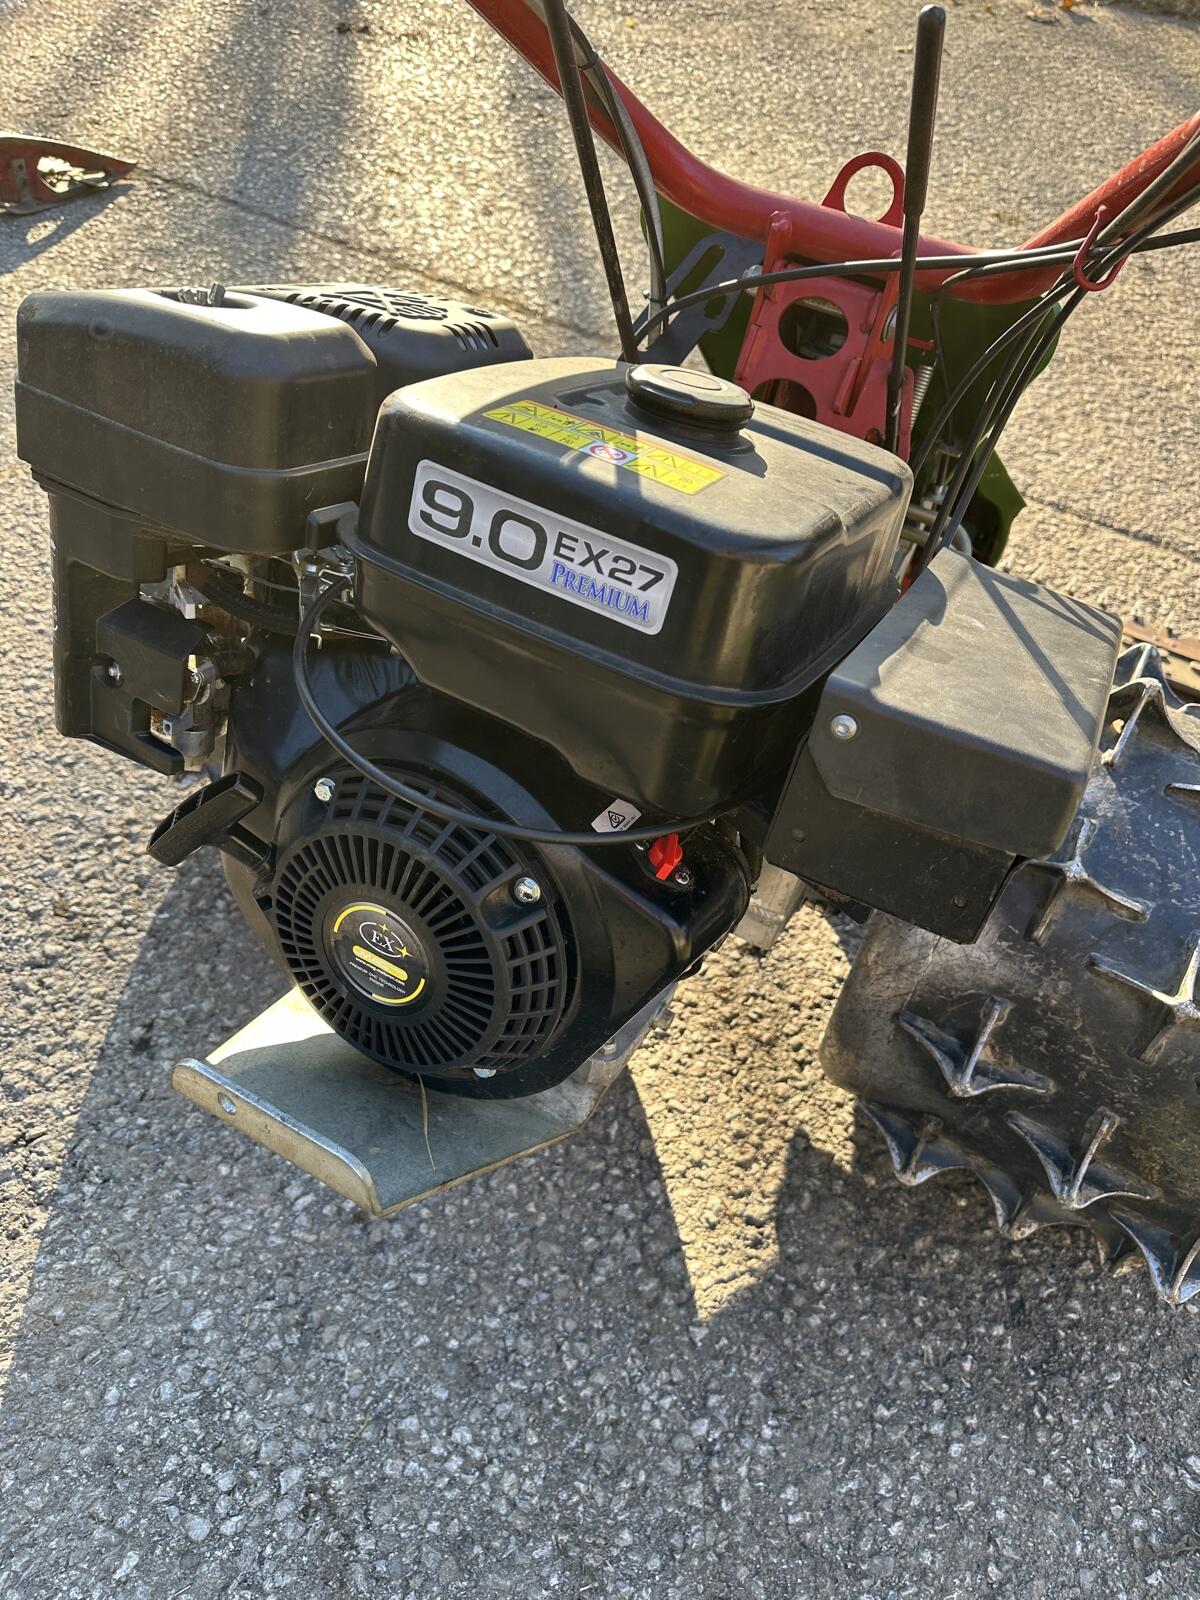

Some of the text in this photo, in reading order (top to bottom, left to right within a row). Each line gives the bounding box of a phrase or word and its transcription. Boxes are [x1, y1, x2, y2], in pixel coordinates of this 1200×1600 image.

[419, 480, 665, 592] 9.0 EX27
[549, 560, 650, 623] PREMIUM
[371, 929, 395, 953] EX
[349, 961, 368, 973] PREMIUM
[379, 977, 406, 994] TECHNOLOGY
